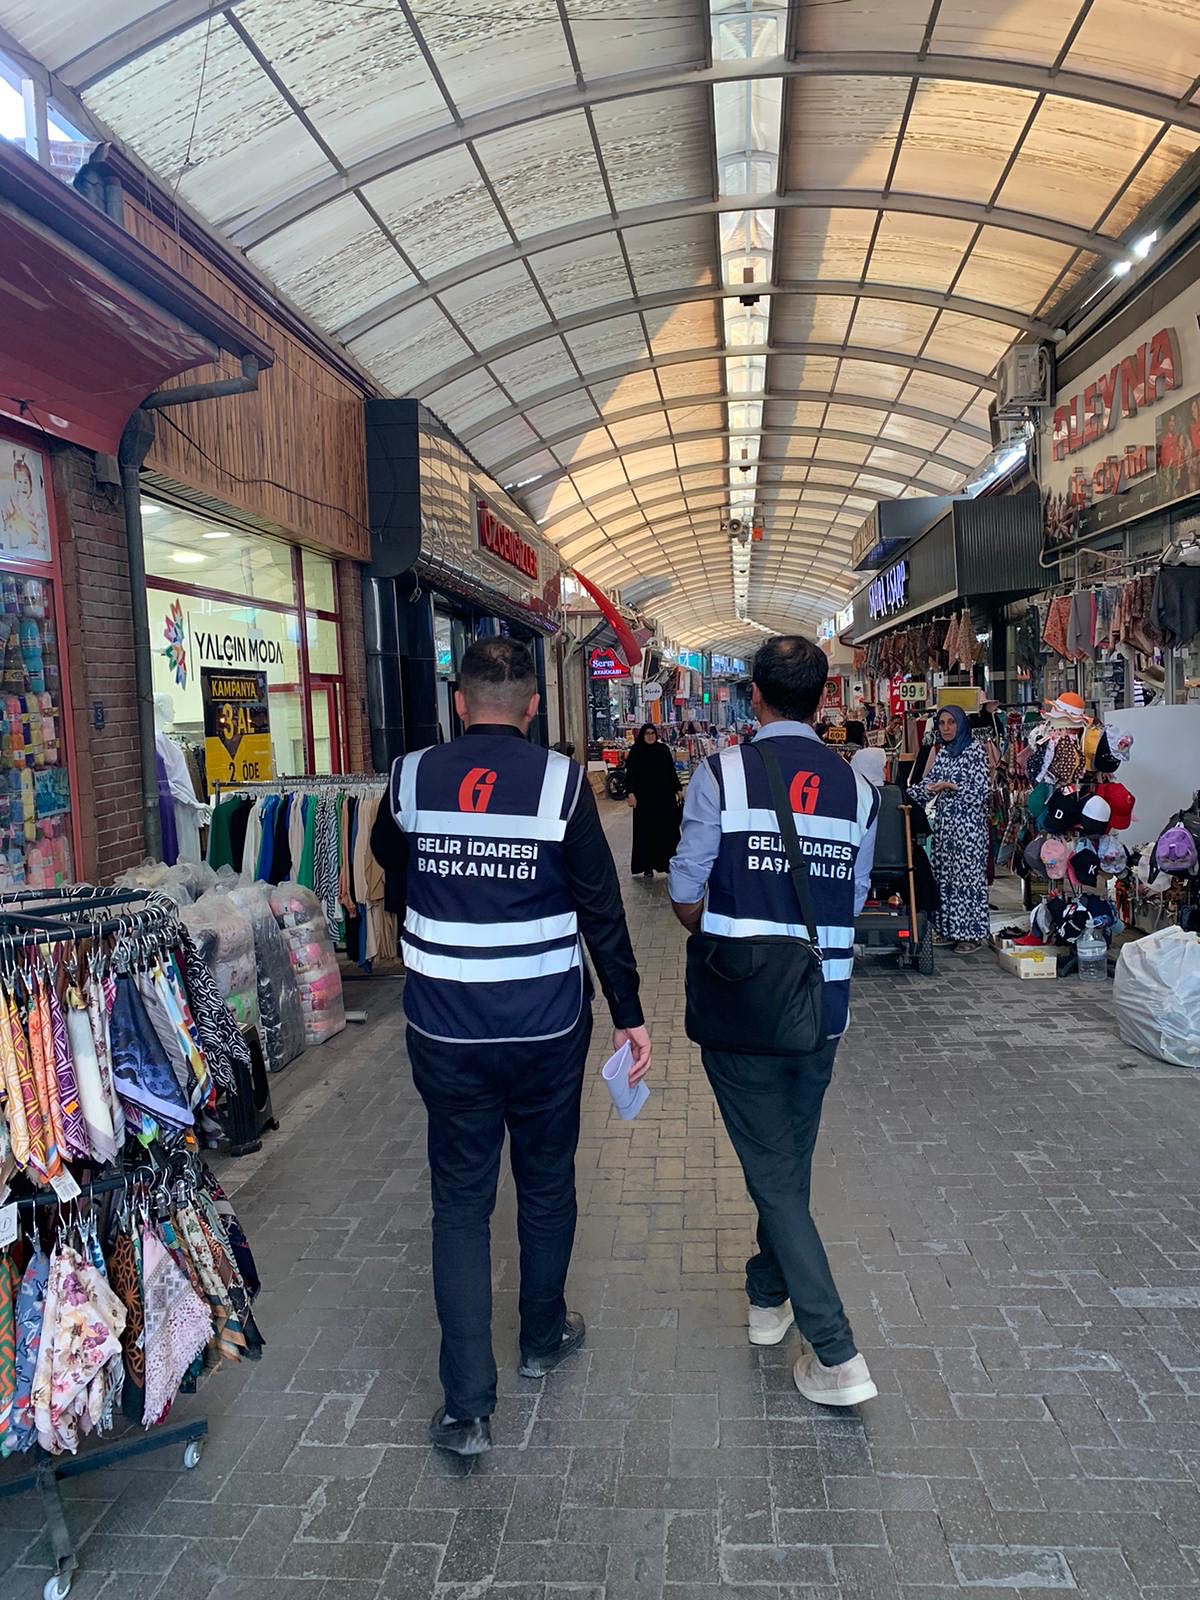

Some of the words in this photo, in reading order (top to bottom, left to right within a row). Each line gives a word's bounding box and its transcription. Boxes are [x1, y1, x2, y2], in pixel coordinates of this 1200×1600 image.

[1053, 328, 1178, 461] ALEYNA
[194, 632, 246, 666] YALÇIN
[249, 638, 284, 664] MODA
[211, 680, 258, 698] KAMPANYA
[222, 703, 234, 740] 3
[237, 707, 255, 734] AL
[228, 762, 236, 782] 2
[242, 760, 260, 779] ÖDE
[1054, 808, 1064, 820] D
[417, 836, 462, 855] GELİR
[467, 838, 538, 860] İDARESİ
[799, 838, 854, 861] İDARES
[418, 857, 536, 880] BAŞKANLIĞI
[1088, 864, 1097, 875] K
